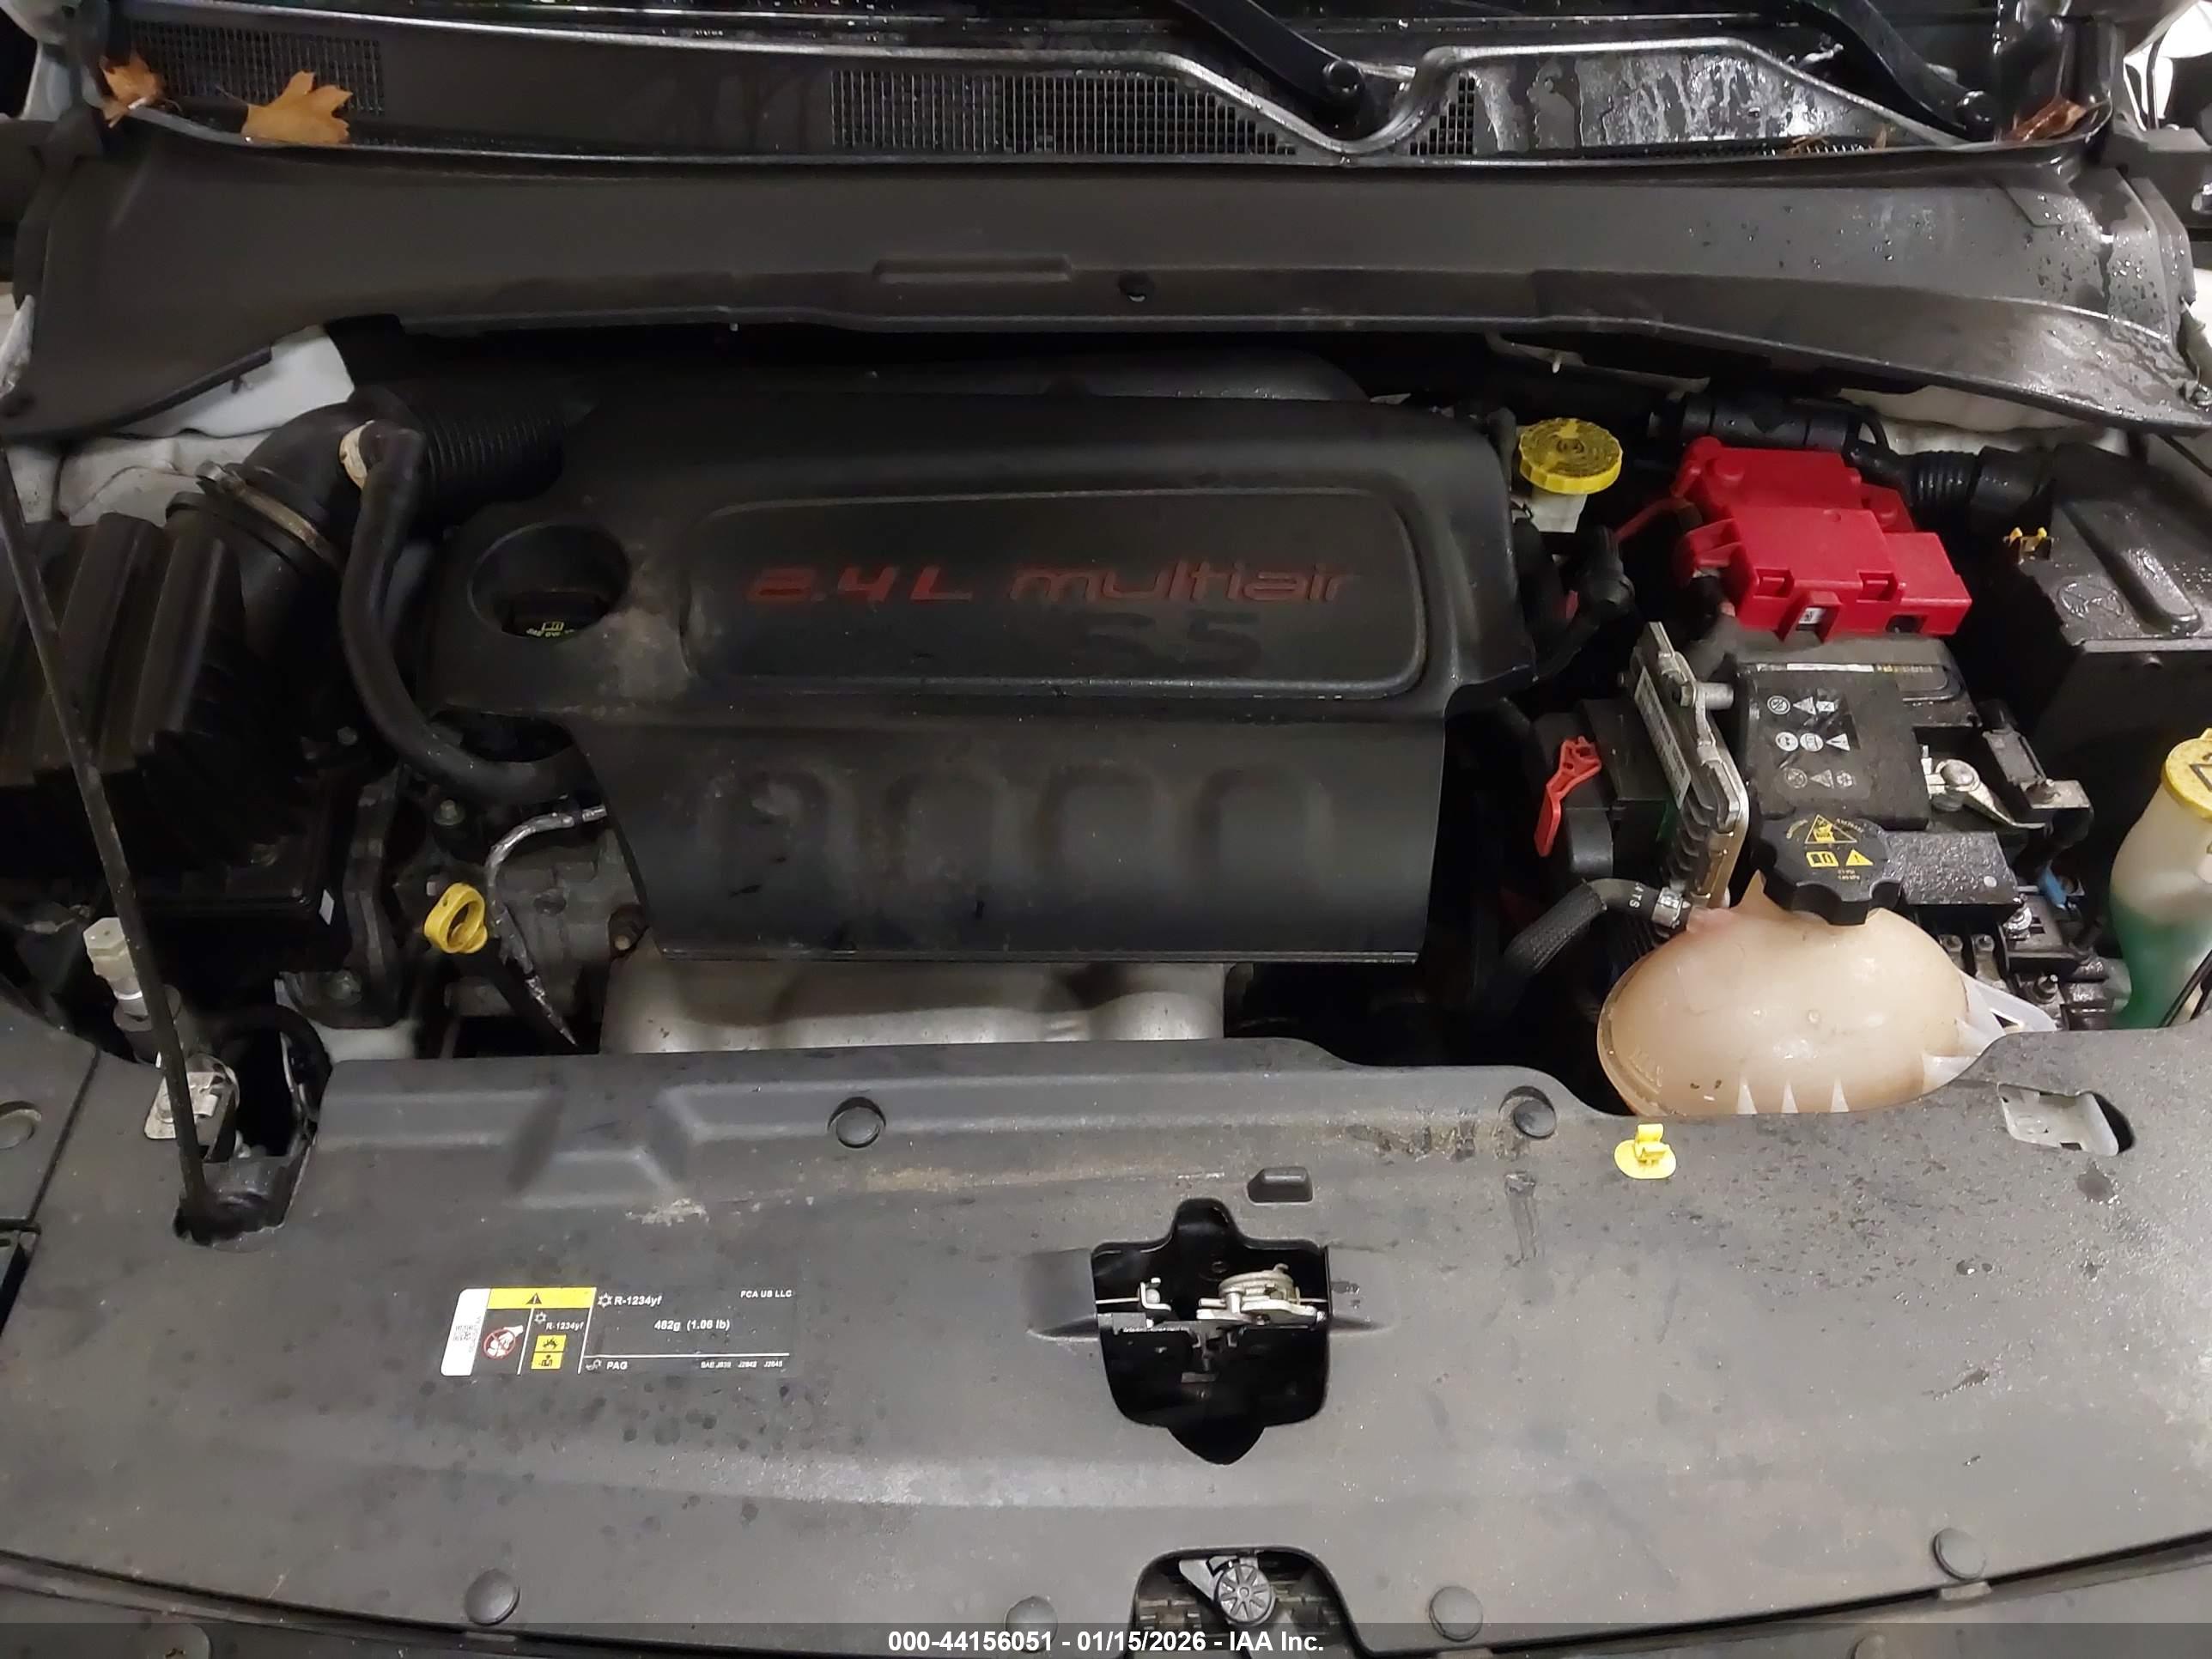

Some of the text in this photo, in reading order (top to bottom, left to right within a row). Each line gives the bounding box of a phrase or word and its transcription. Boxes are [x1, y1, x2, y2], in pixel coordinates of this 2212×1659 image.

[1005, 560, 1357, 603] multiair
[740, 1290, 759, 1298] FCA
[775, 1289, 793, 1298] LLC
[614, 1295, 663, 1308] R-1234yf
[545, 1321, 585, 1332] R-1234yf
[715, 1319, 731, 1332] lb)
[606, 1360, 628, 1370] PAG
